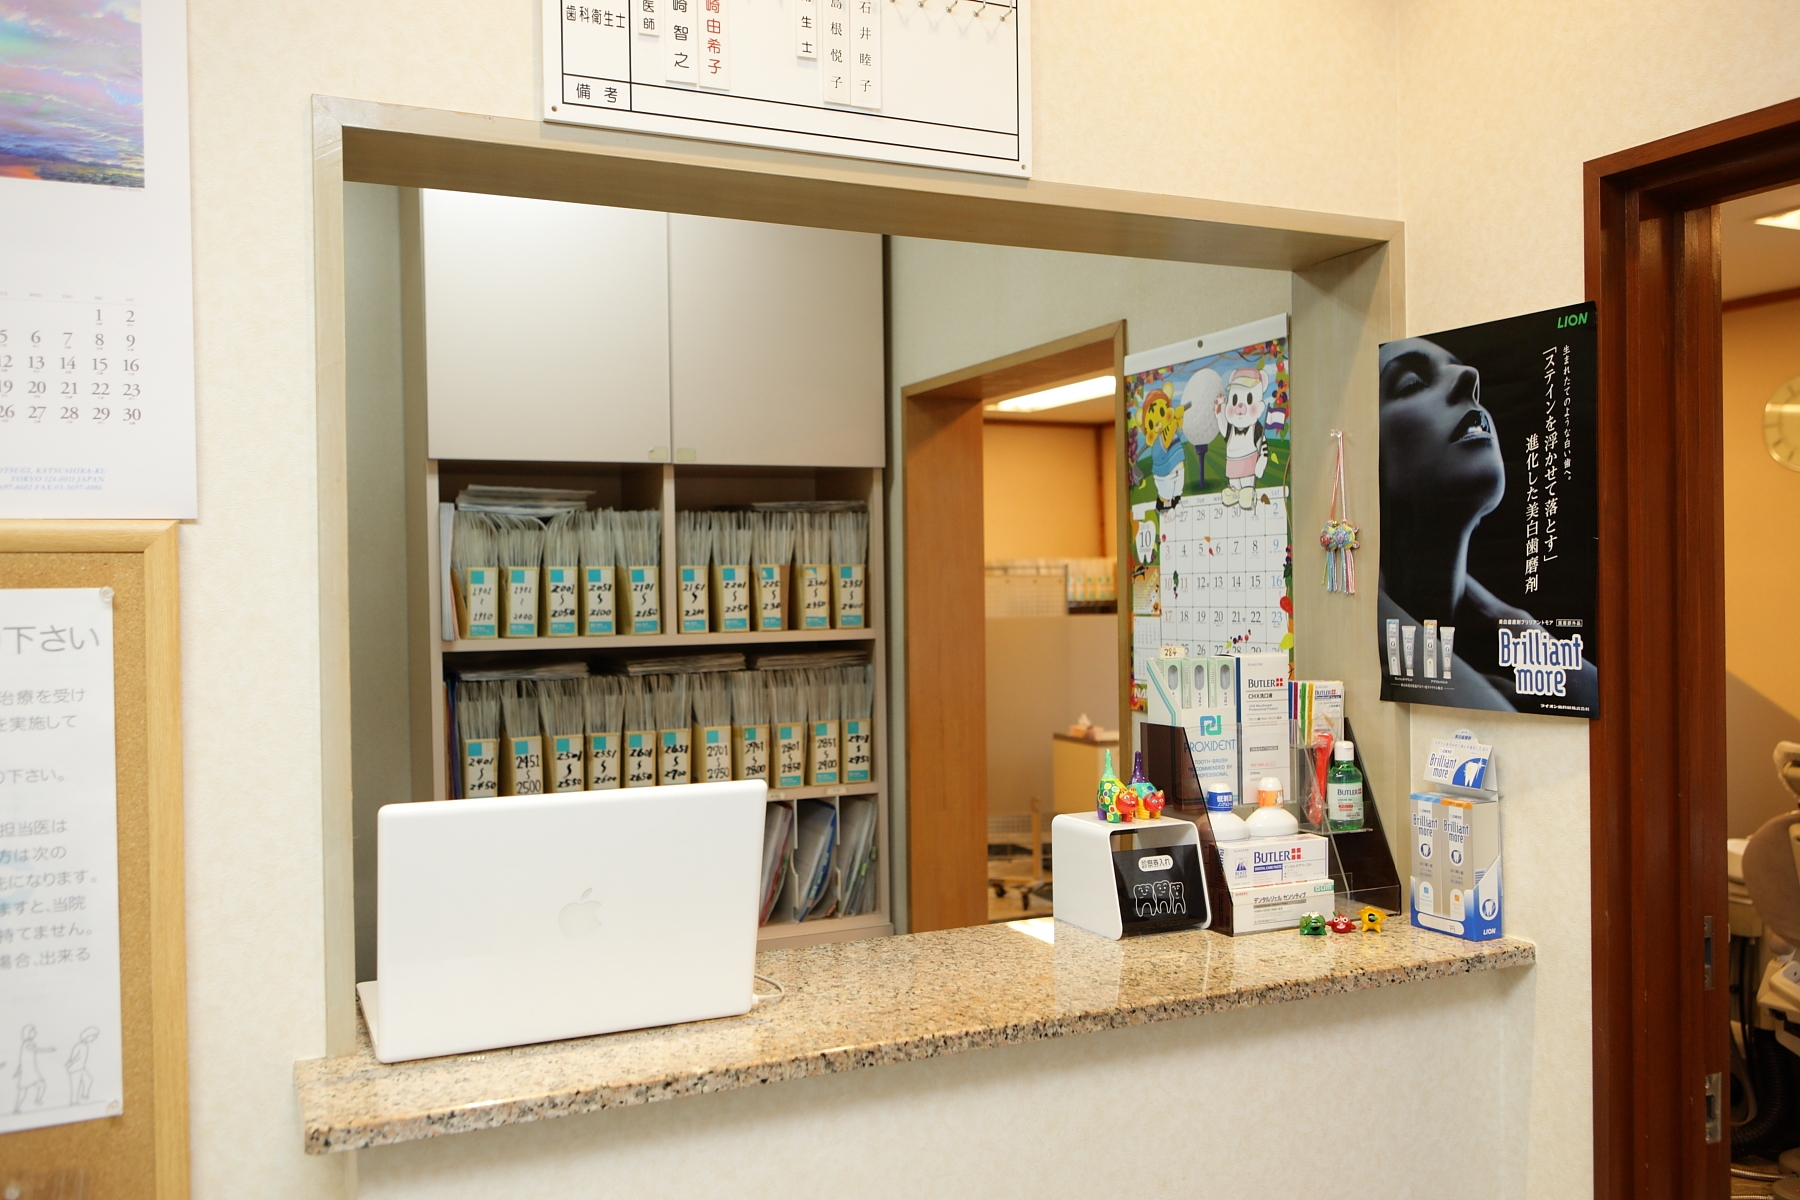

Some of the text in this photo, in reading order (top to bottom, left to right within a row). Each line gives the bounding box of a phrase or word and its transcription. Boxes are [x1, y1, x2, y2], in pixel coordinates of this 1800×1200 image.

[566, 5, 626, 28] 歯科衛生士
[860, 1, 872, 92] 石井睦子
[576, 83, 618, 103] 備考
[96, 309, 135, 322] 1 2
[1557, 312, 1588, 329] LION
[0, 329, 135, 347] 5 6 7 8 9
[28, 356, 45, 370] 13
[60, 356, 76, 370] 14
[92, 358, 108, 372] 15
[124, 358, 140, 372] 16
[28, 381, 46, 394] 20
[61, 382, 77, 395] 21
[92, 383, 110, 396] 22
[123, 383, 140, 397] 23
[0, 405, 141, 421] 26 27 28 29 30
[1563, 345, 1572, 480] 生まれたてのような白い歯へ。
[1543, 346, 1558, 562] 「ステインを浮かせて落とす」
[1180, 511, 1188, 522] 27
[1197, 510, 1205, 521] 28
[1214, 508, 1223, 519] 29
[1273, 502, 1279, 515] 2
[1525, 433, 1540, 594] 進化した美白歯磨剤
[1139, 530, 1152, 548] 10
[1166, 539, 1279, 557] 3 4 5 6 7 8 9
[589, 584, 612, 592] 2051
[634, 583, 654, 592] 2101
[1164, 575, 1282, 588] 10 11 12 13 14 15 16
[551, 584, 575, 594] 2001
[551, 609, 575, 618] 2050
[635, 609, 658, 617] 2150
[1165, 611, 1282, 623] 17 18 19 20 21 22 23
[3, 625, 100, 654] 下さい
[1197, 644, 1205, 655] 26
[1214, 645, 1223, 656] 27
[1500, 630, 1582, 668] Brilliant
[1248, 679, 1275, 688] BUTLER
[1516, 669, 1564, 694] more
[781, 741, 799, 753] 2801
[817, 736, 836, 748] 2851
[594, 750, 618, 758] 2551
[630, 748, 653, 758] 2601
[665, 744, 688, 754] 2651
[706, 745, 728, 757] 2701
[469, 758, 494, 767] 2401
[516, 754, 540, 770] 2451
[818, 760, 837, 770] 2900
[1430, 753, 1457, 769] Brilliant
[630, 773, 652, 781] 2650
[707, 767, 729, 779] 2750
[746, 765, 766, 776] 2800
[1433, 768, 1448, 778] more
[470, 782, 496, 791] 2450
[516, 780, 541, 795] 2500
[1413, 814, 1437, 829] Brilliant
[1444, 820, 1468, 835] Brilliant
[1419, 827, 1432, 837] more
[1449, 833, 1463, 843] more
[1254, 851, 1290, 864] BUTLER
